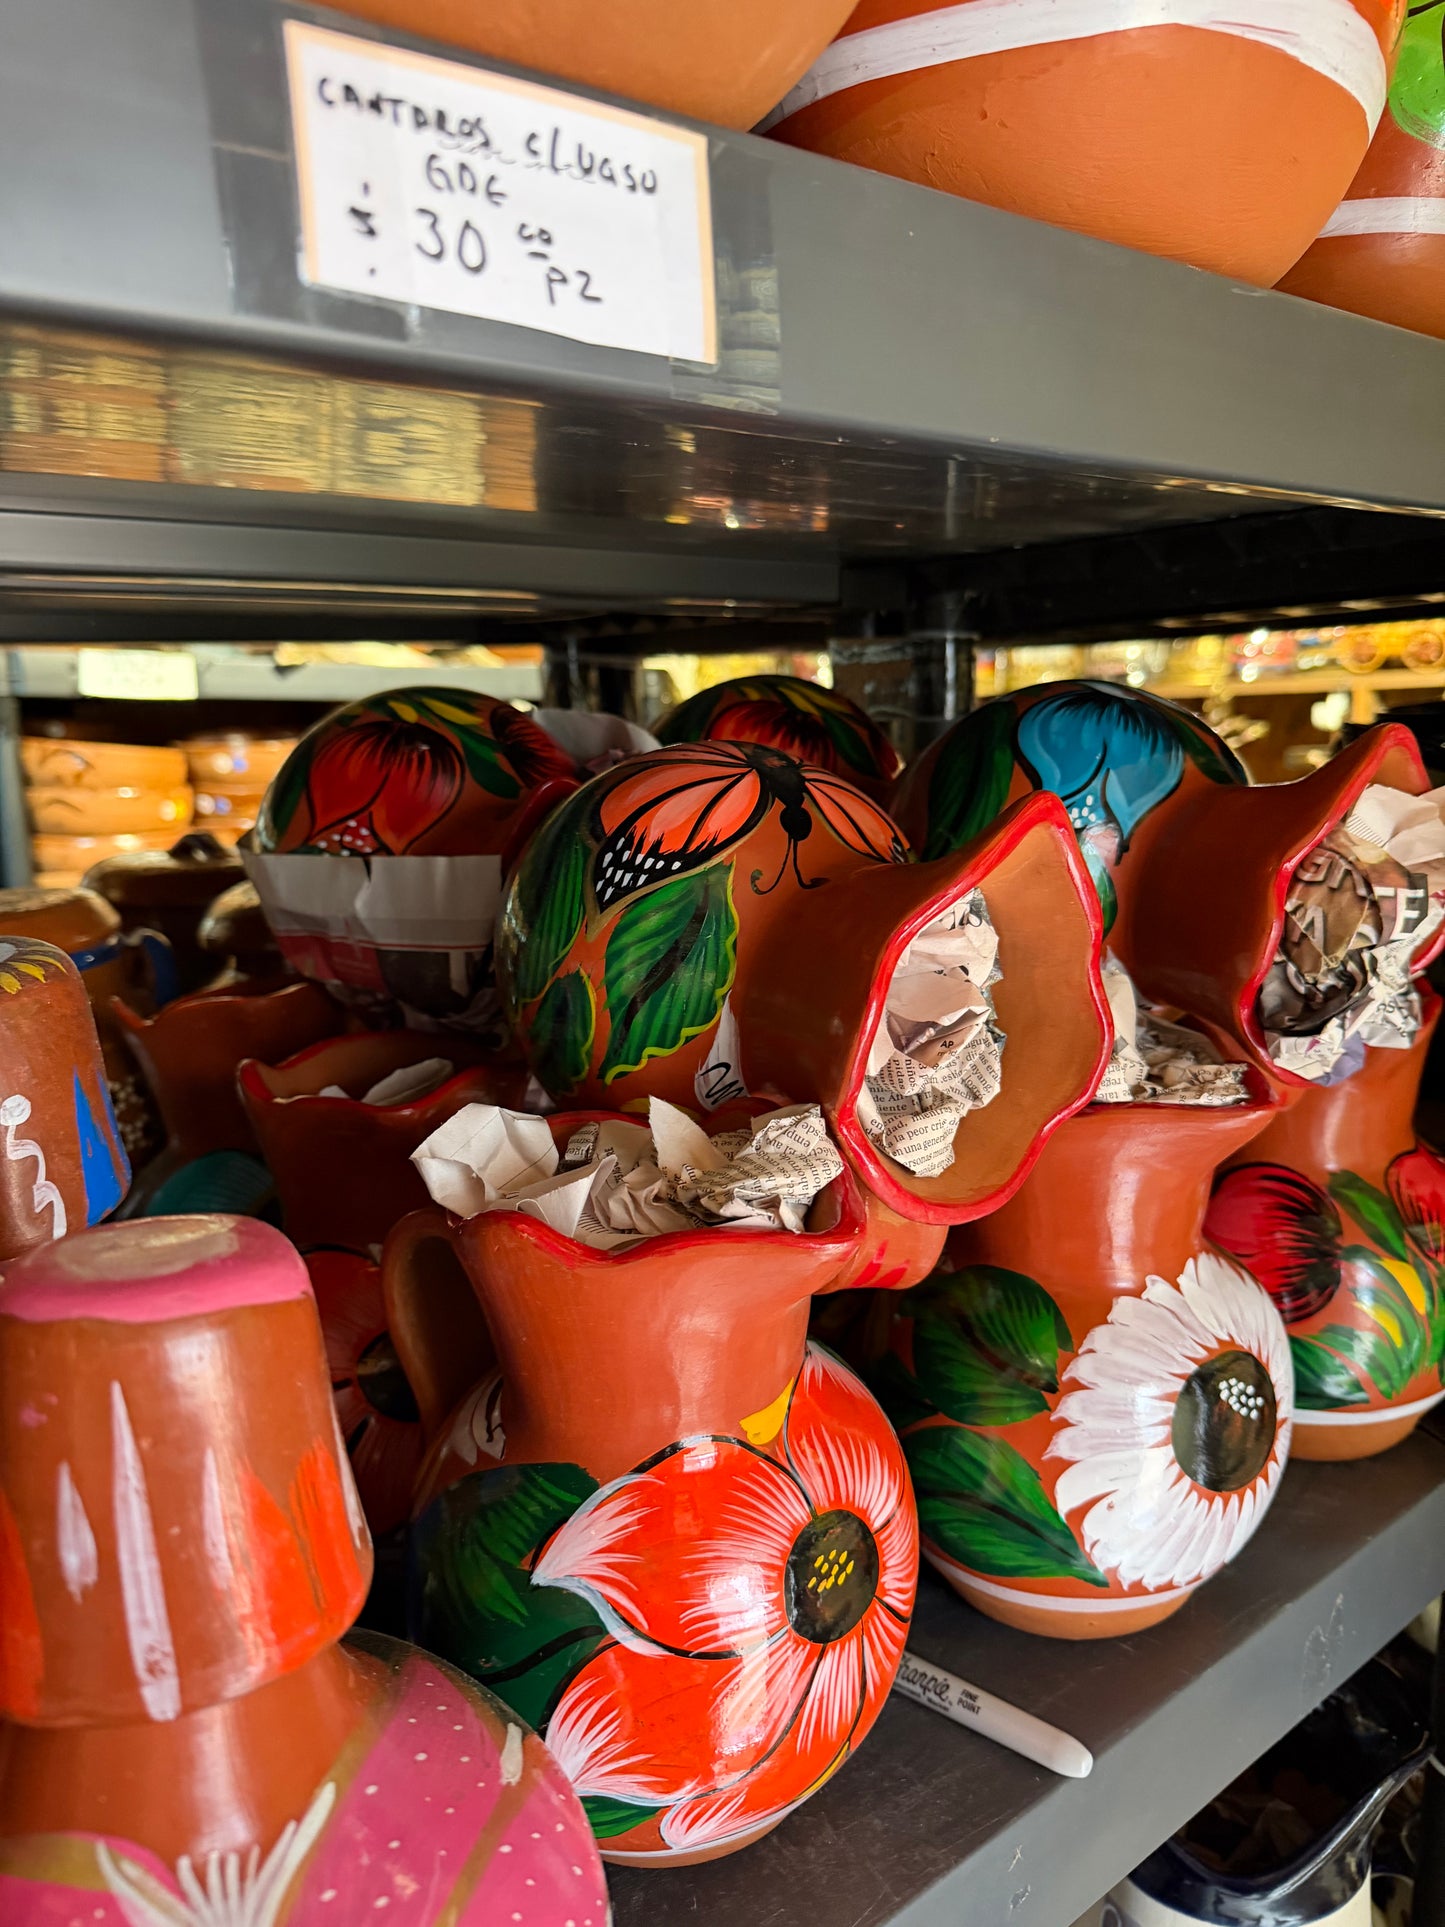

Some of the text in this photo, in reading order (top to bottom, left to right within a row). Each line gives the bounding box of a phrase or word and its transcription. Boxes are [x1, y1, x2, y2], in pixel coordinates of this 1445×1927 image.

[416, 208, 488, 274] 30
[940, 1040, 954, 1049] AP
[893, 1134, 905, 1143] la
[906, 1126, 929, 1140] peor
[904, 1144, 922, 1154] una
[899, 1653, 950, 1702] harpie
[960, 1688, 980, 1703] FINE
[956, 1697, 981, 1715] POINT
